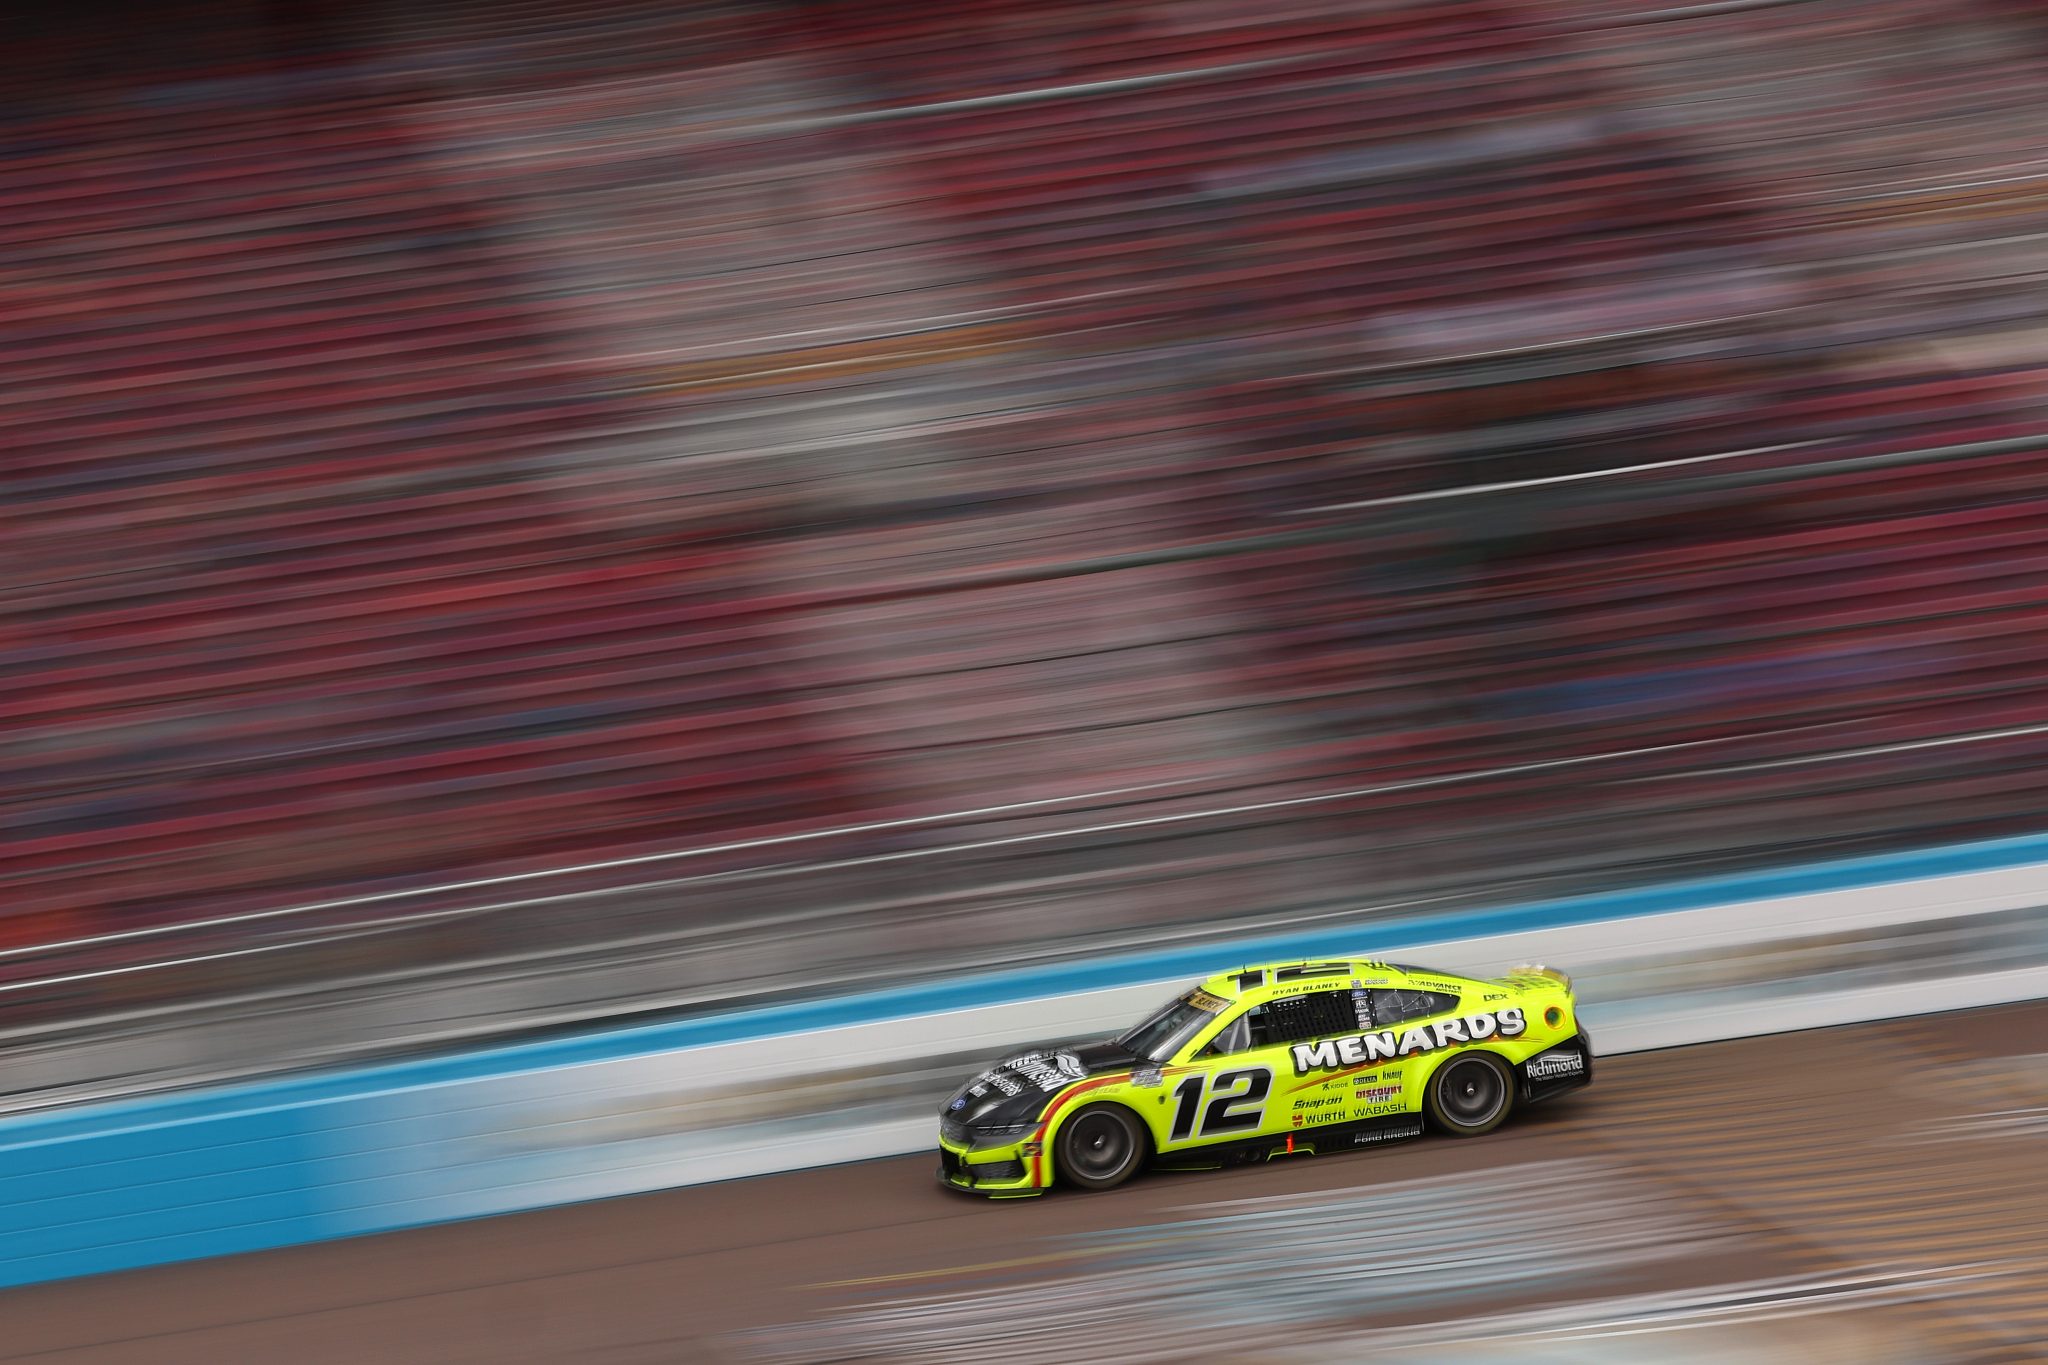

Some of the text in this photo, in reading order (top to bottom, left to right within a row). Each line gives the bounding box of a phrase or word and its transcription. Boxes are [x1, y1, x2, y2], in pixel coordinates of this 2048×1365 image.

[1272, 986, 1300, 996] RYAN
[1302, 982, 1341, 992] BLANEY
[1419, 981, 1462, 991] ADVANCE
[1483, 993, 1509, 1002] DEX
[1292, 1007, 1526, 1075] MENARDS
[1526, 1053, 1584, 1079] Richmond
[1383, 1070, 1402, 1080] KNAUF
[1355, 1085, 1402, 1099] DISCOUNT
[1368, 1094, 1392, 1104] TIRE
[1168, 1066, 1274, 1144] 12
[1293, 1096, 1343, 1110] Snap-on
[1354, 1103, 1408, 1117] WABASH
[1354, 1130, 1420, 1143] FORD RACING
